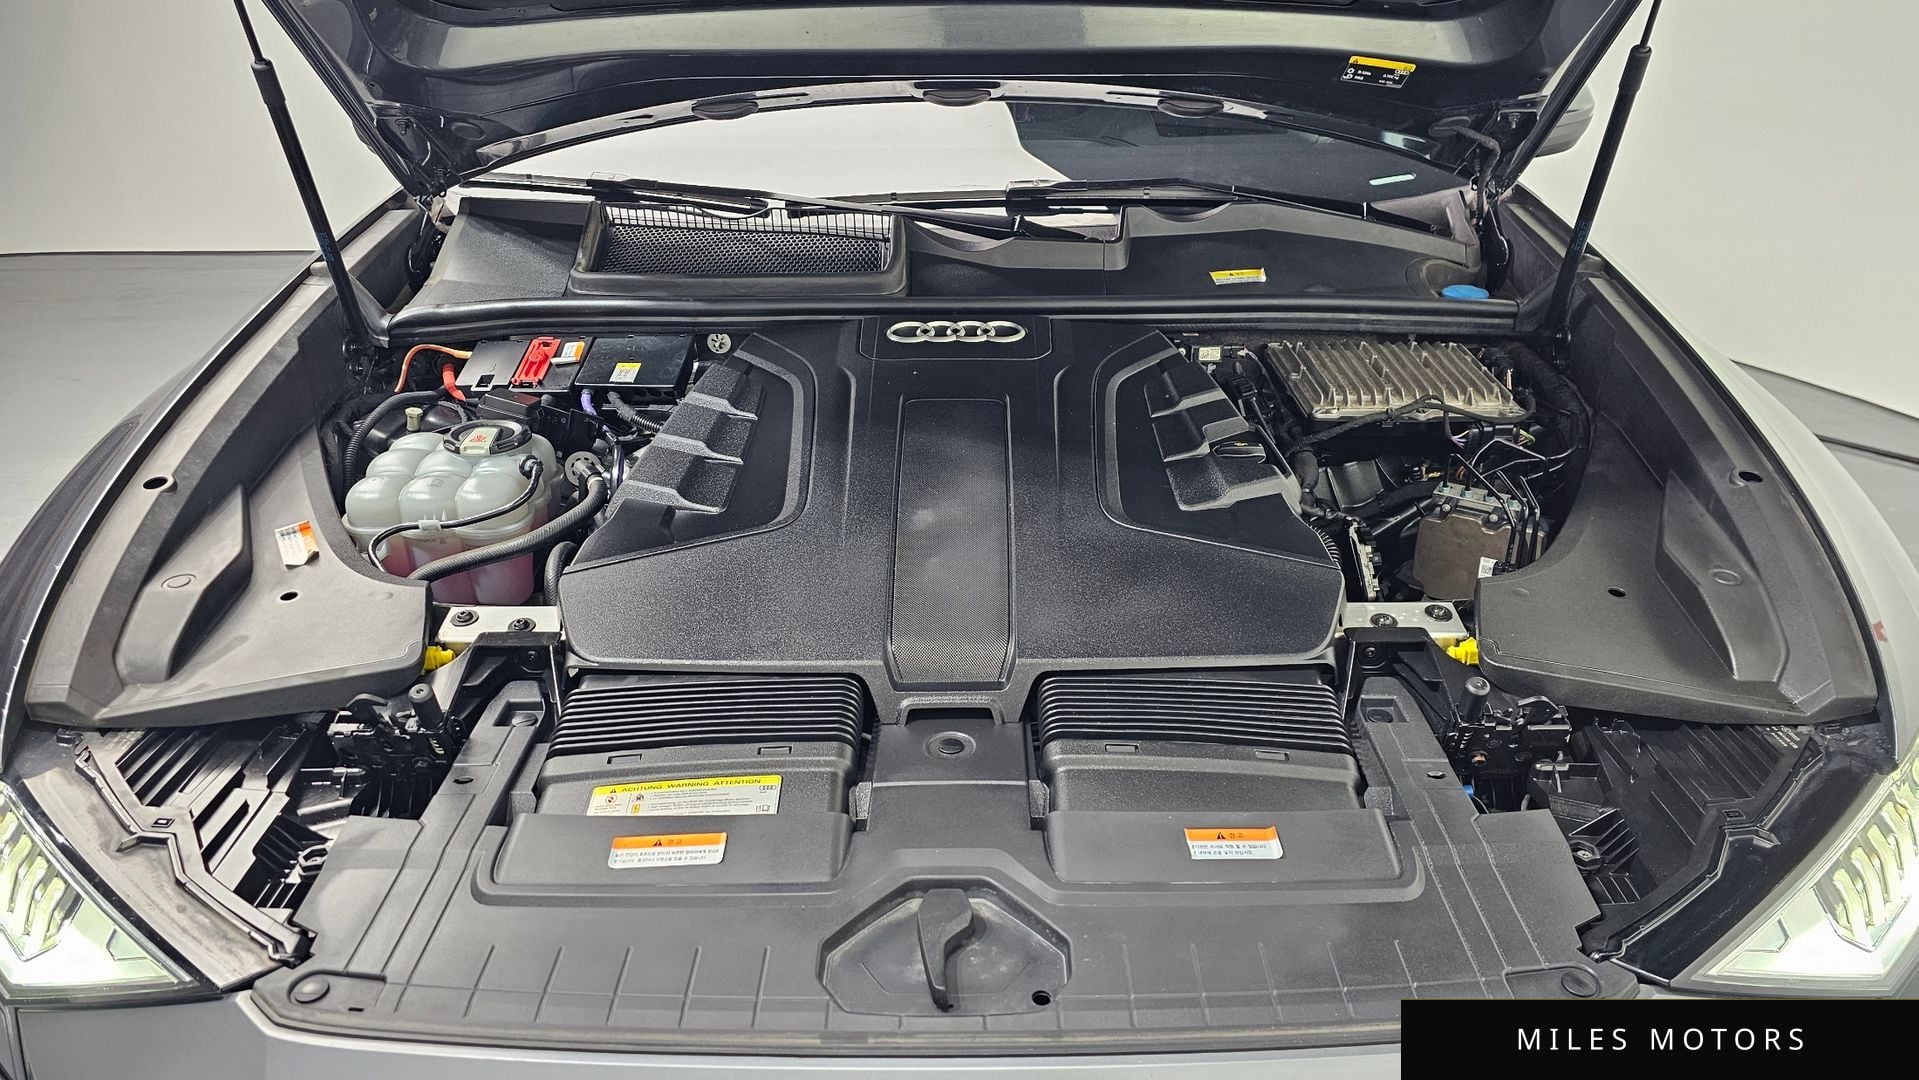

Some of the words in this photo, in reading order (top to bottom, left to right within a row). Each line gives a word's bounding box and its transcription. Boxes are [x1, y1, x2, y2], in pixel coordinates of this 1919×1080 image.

[621, 785, 663, 793] ACHTUNG
[667, 781, 709, 789] WARNING
[713, 778, 761, 786] ATTENTION
